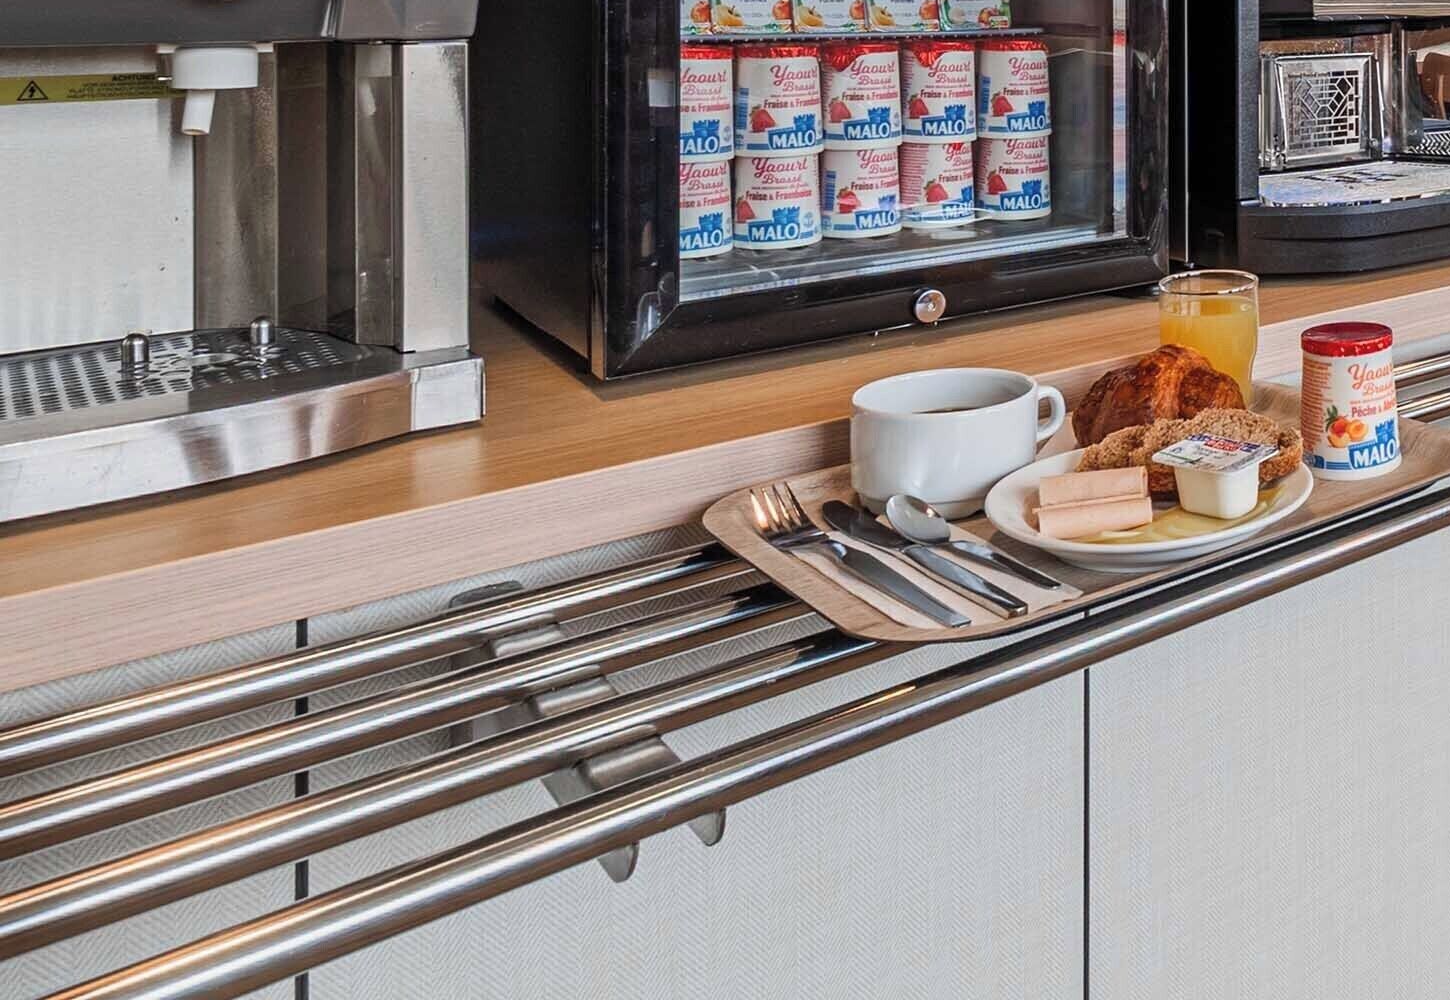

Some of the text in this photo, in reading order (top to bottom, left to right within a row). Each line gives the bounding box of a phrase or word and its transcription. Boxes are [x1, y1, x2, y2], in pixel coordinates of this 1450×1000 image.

[769, 65, 818, 86] Yaourt
[849, 59, 896, 79] Yaourt
[920, 89, 942, 98] Fraise
[1003, 88, 1024, 96] Fraise
[763, 99, 788, 109] Fraise
[847, 122, 890, 139] MALO
[925, 120, 965, 135] MALO
[1010, 115, 1045, 131] MALO
[773, 129, 815, 149] MALO
[680, 161, 727, 185] Yaourt
[751, 157, 809, 178] Yaourt
[998, 166, 1019, 175] Fraise
[745, 190, 768, 201] Fraise
[1003, 194, 1041, 210] MALO
[859, 210, 896, 229] MALO
[680, 229, 722, 249] MALO
[751, 222, 799, 241] MALO
[1354, 438, 1396, 469] MALO
